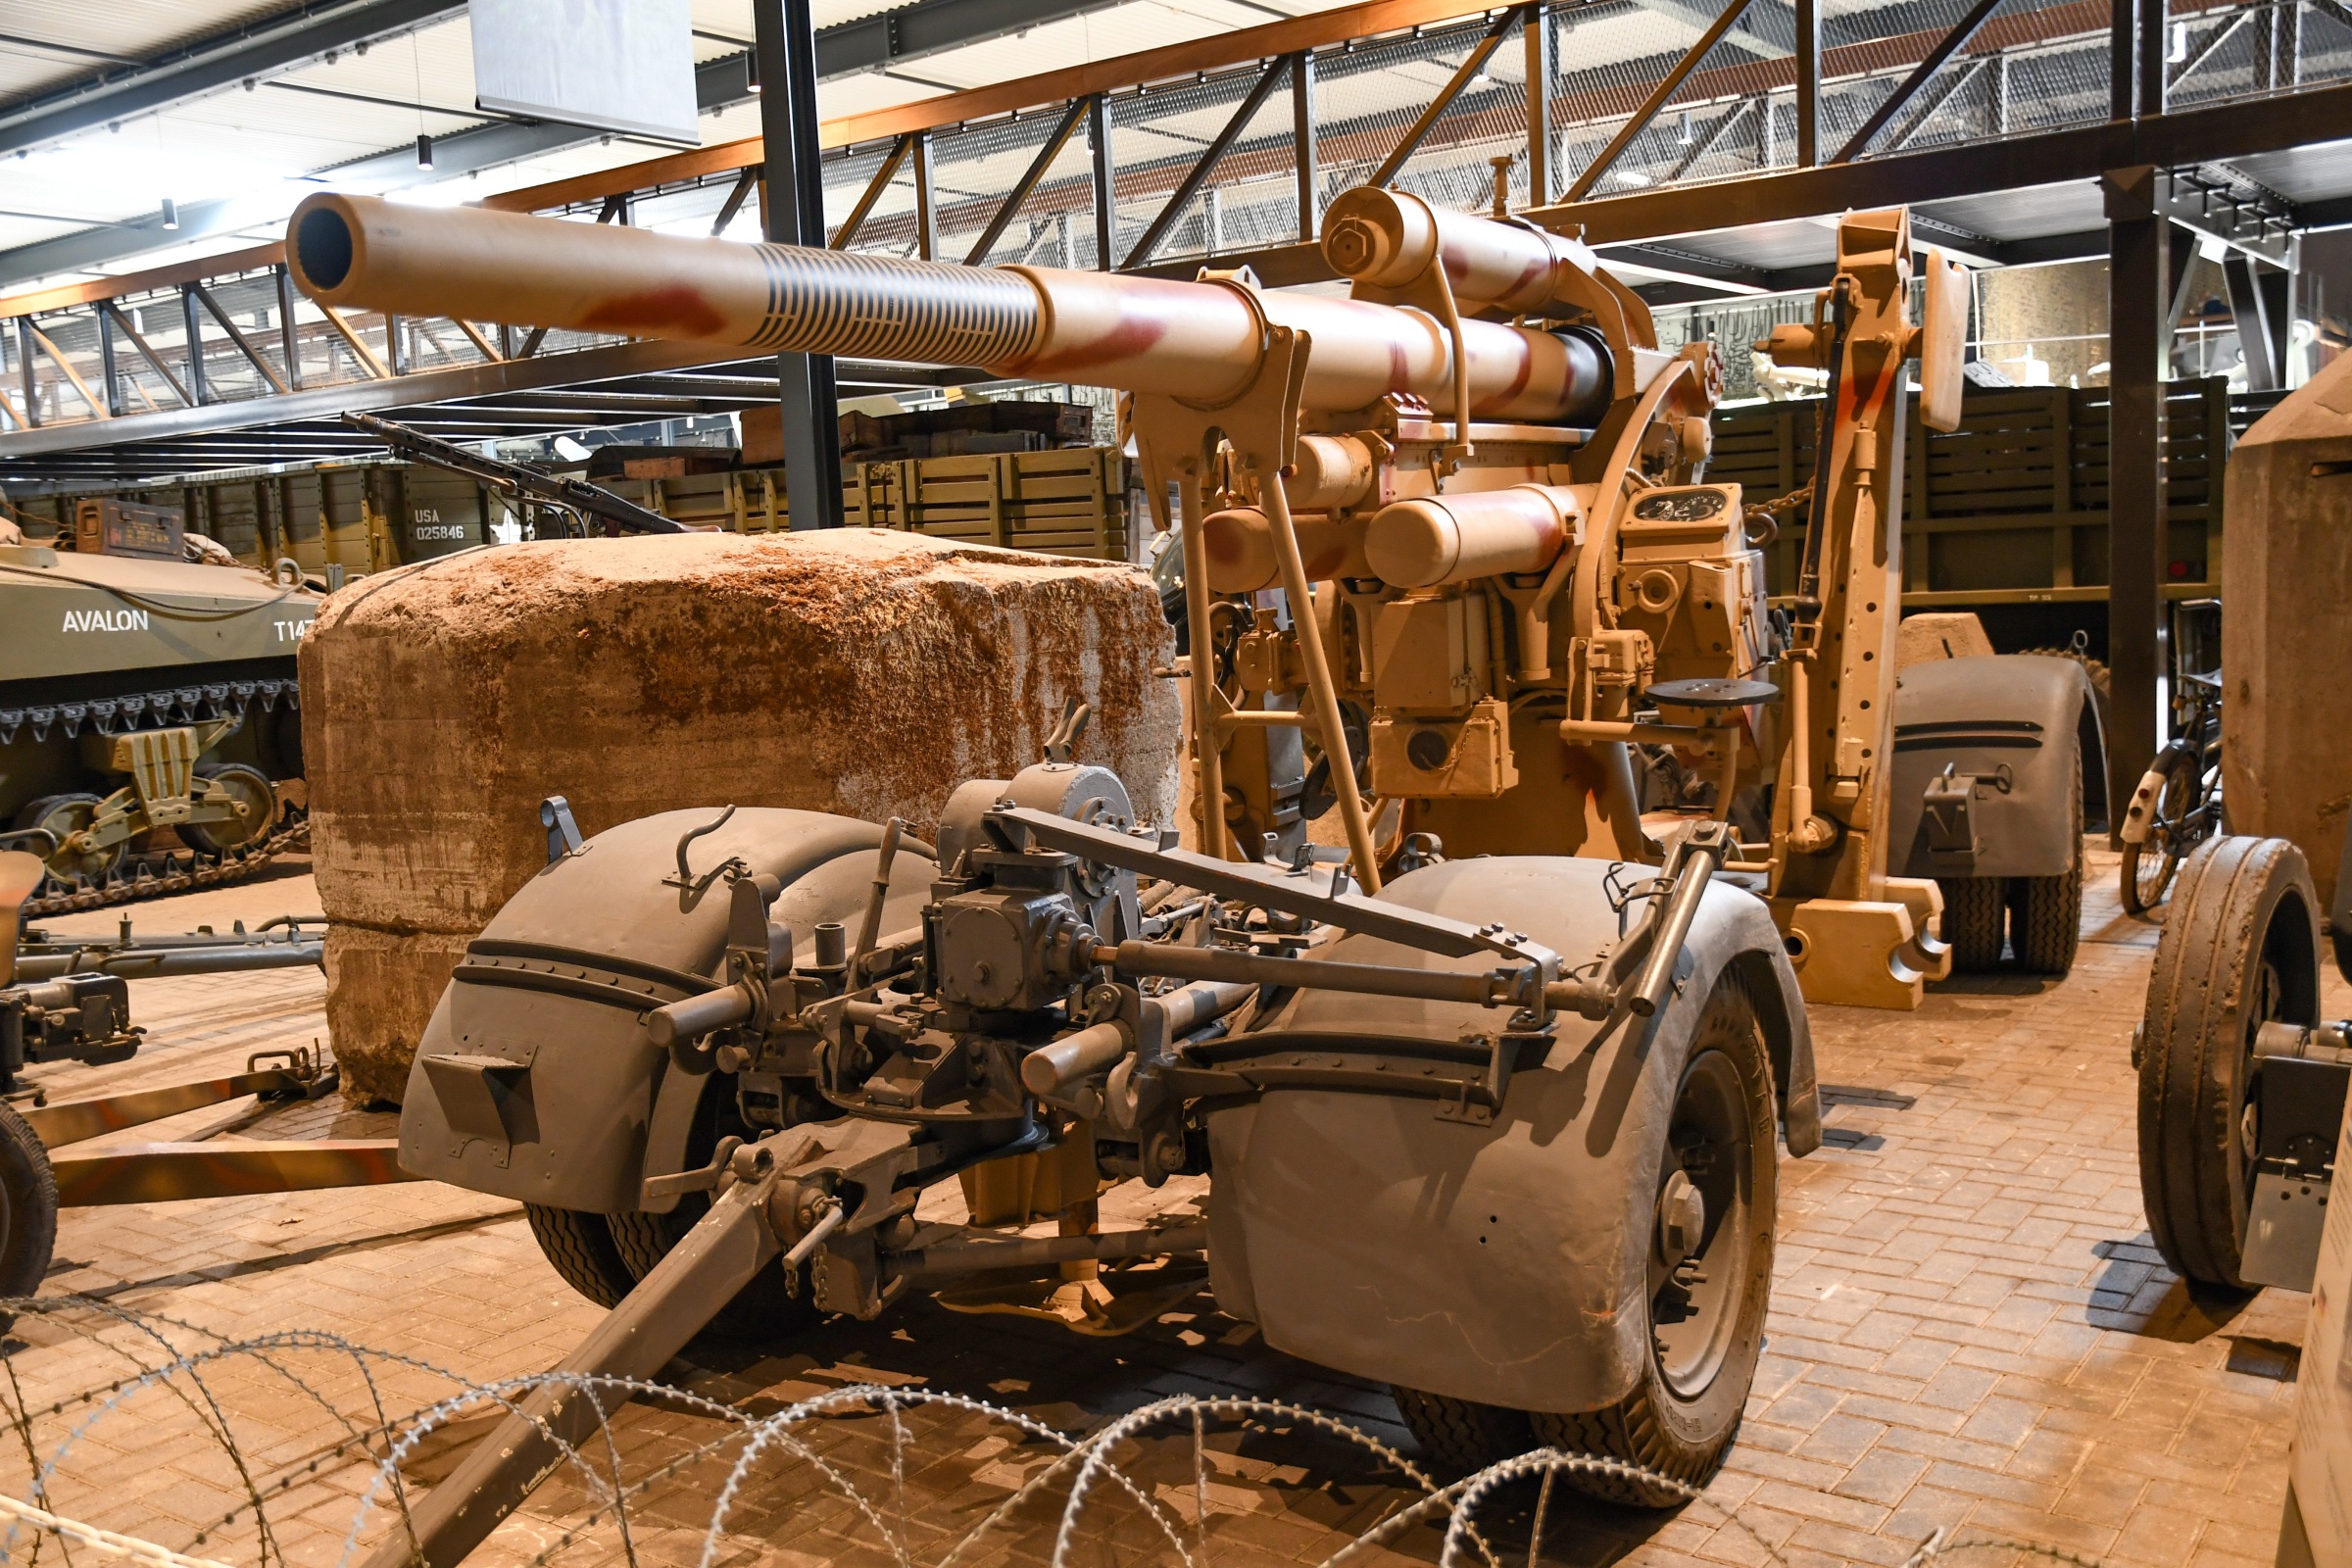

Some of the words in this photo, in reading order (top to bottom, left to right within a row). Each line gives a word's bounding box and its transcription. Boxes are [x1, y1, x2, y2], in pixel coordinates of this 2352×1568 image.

[415, 509, 440, 523] USA
[416, 525, 465, 540] 025846
[62, 610, 149, 632] AVALON
